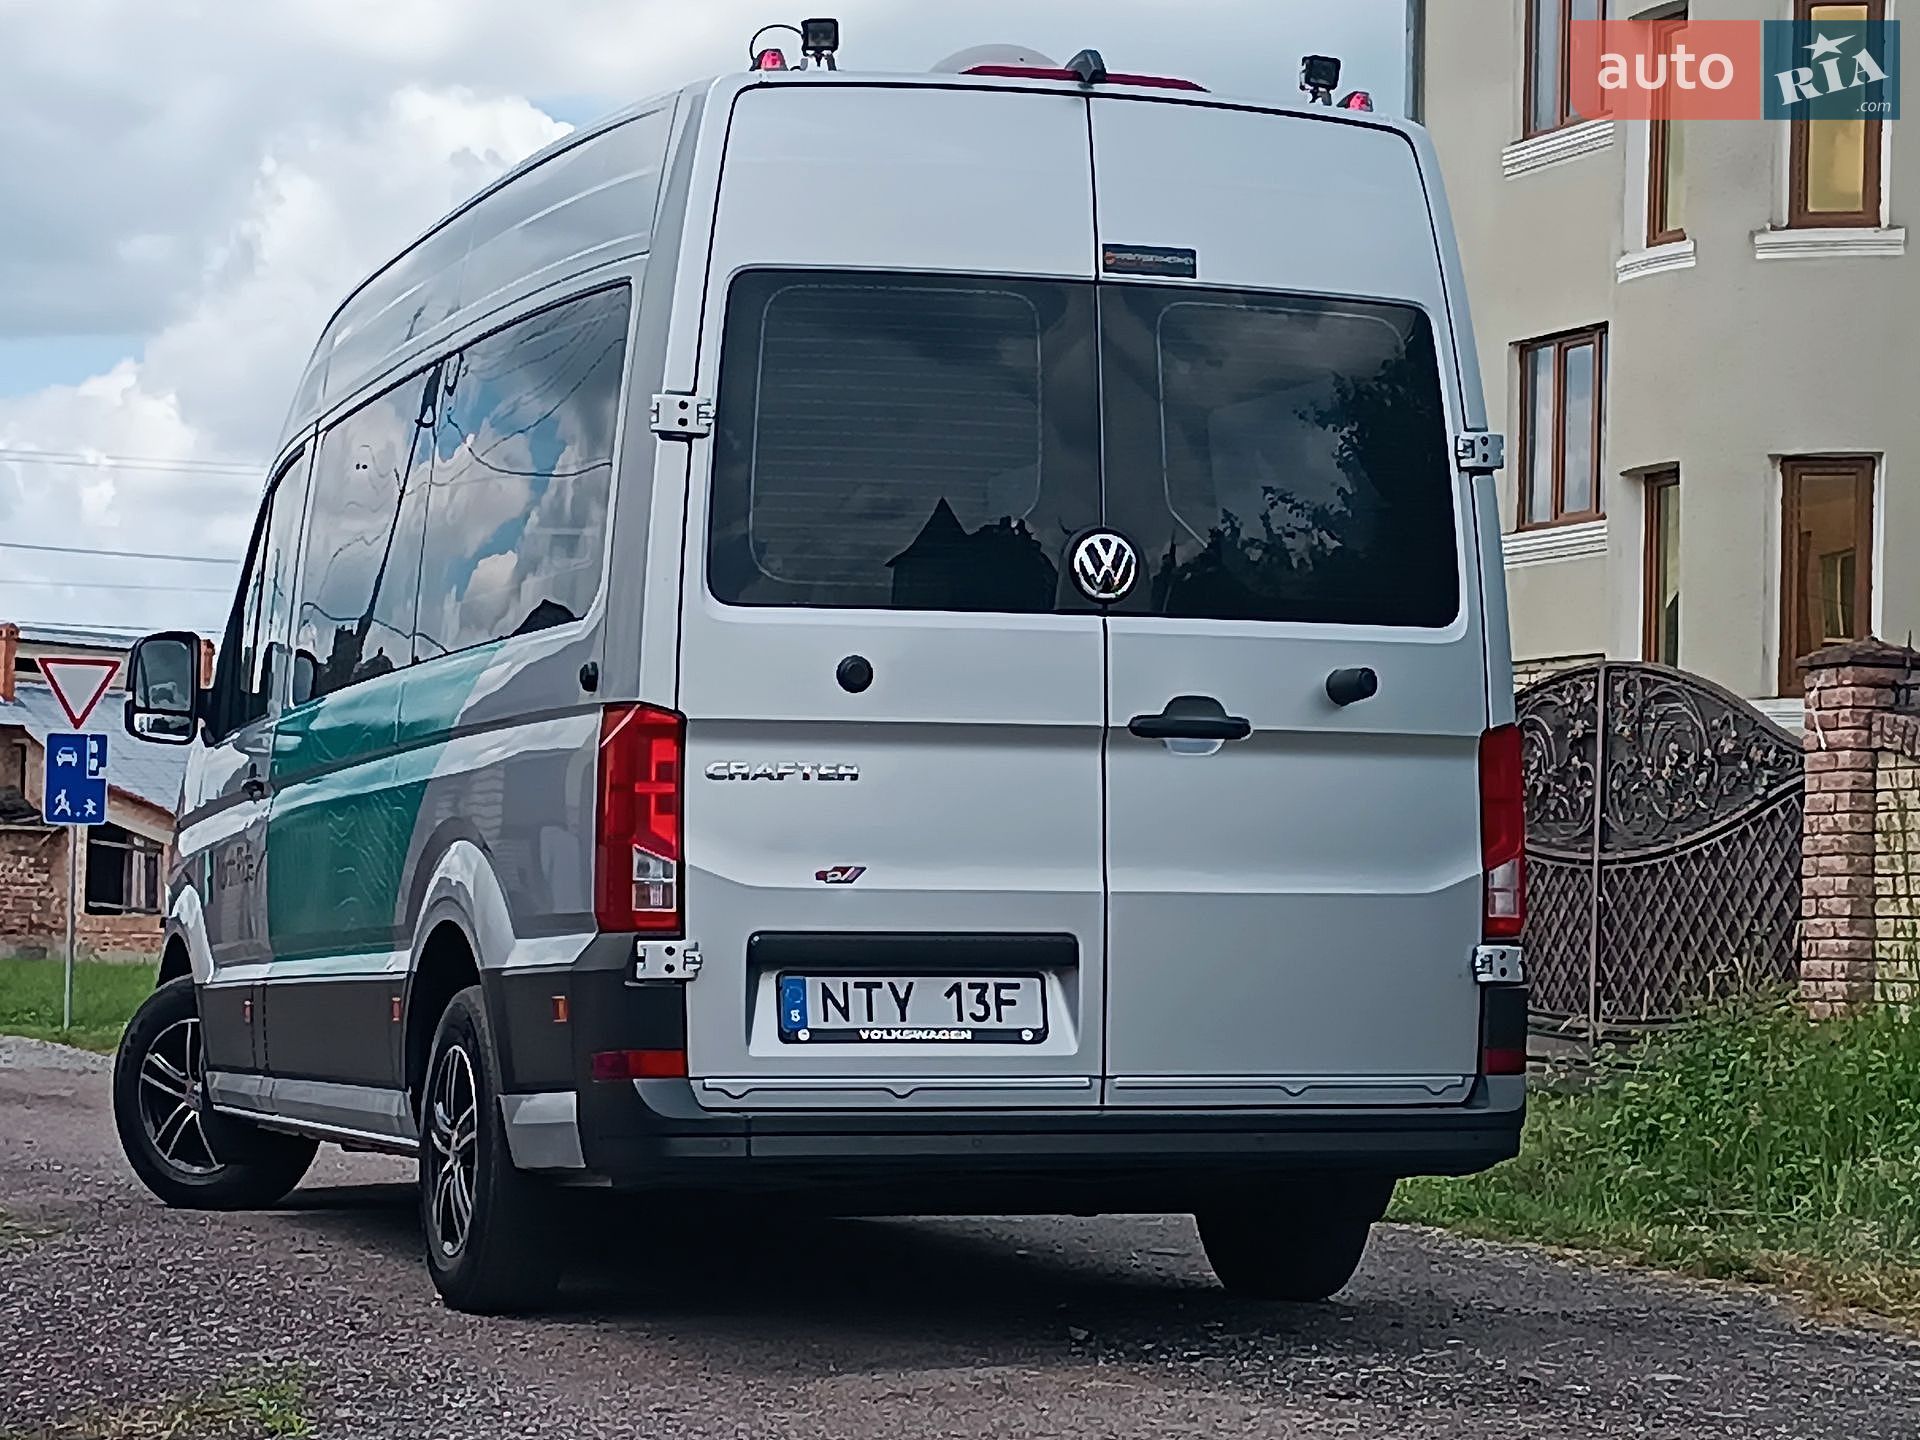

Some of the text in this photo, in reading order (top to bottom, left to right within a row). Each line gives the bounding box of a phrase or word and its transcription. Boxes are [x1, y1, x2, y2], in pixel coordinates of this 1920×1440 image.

[705, 761, 860, 781] CRAFTER
[820, 981, 1021, 1023] NTY 13F
[859, 1029, 972, 1040] VOLKSWAGEN
